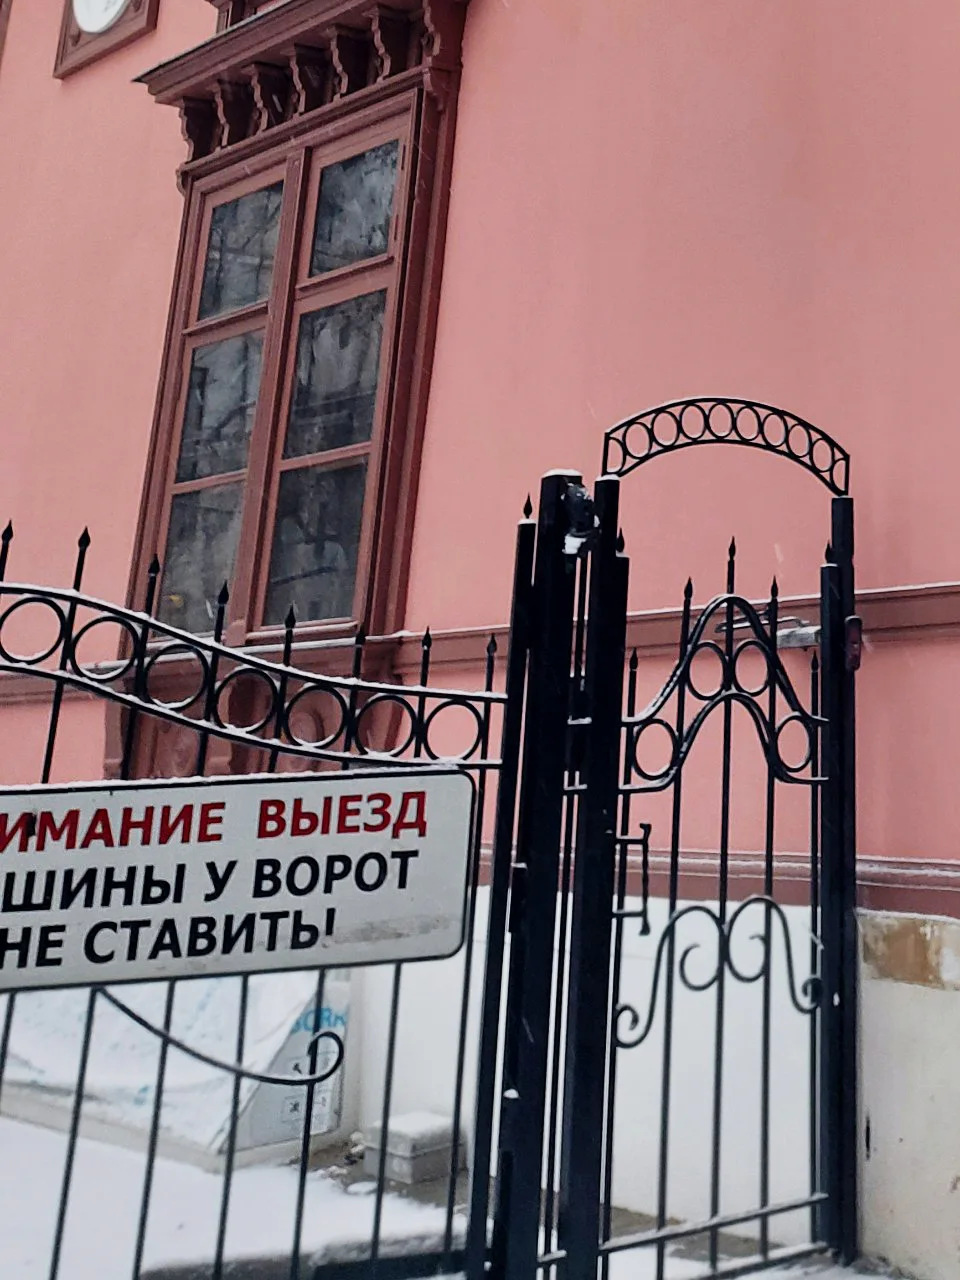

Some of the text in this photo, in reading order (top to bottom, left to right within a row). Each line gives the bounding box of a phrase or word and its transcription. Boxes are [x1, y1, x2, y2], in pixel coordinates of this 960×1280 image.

[257, 791, 427, 839] ВЫЕЗД
[203, 860, 237, 902] У
[252, 850, 419, 899] ВОРОТ
[0, 924, 65, 969] НЕ
